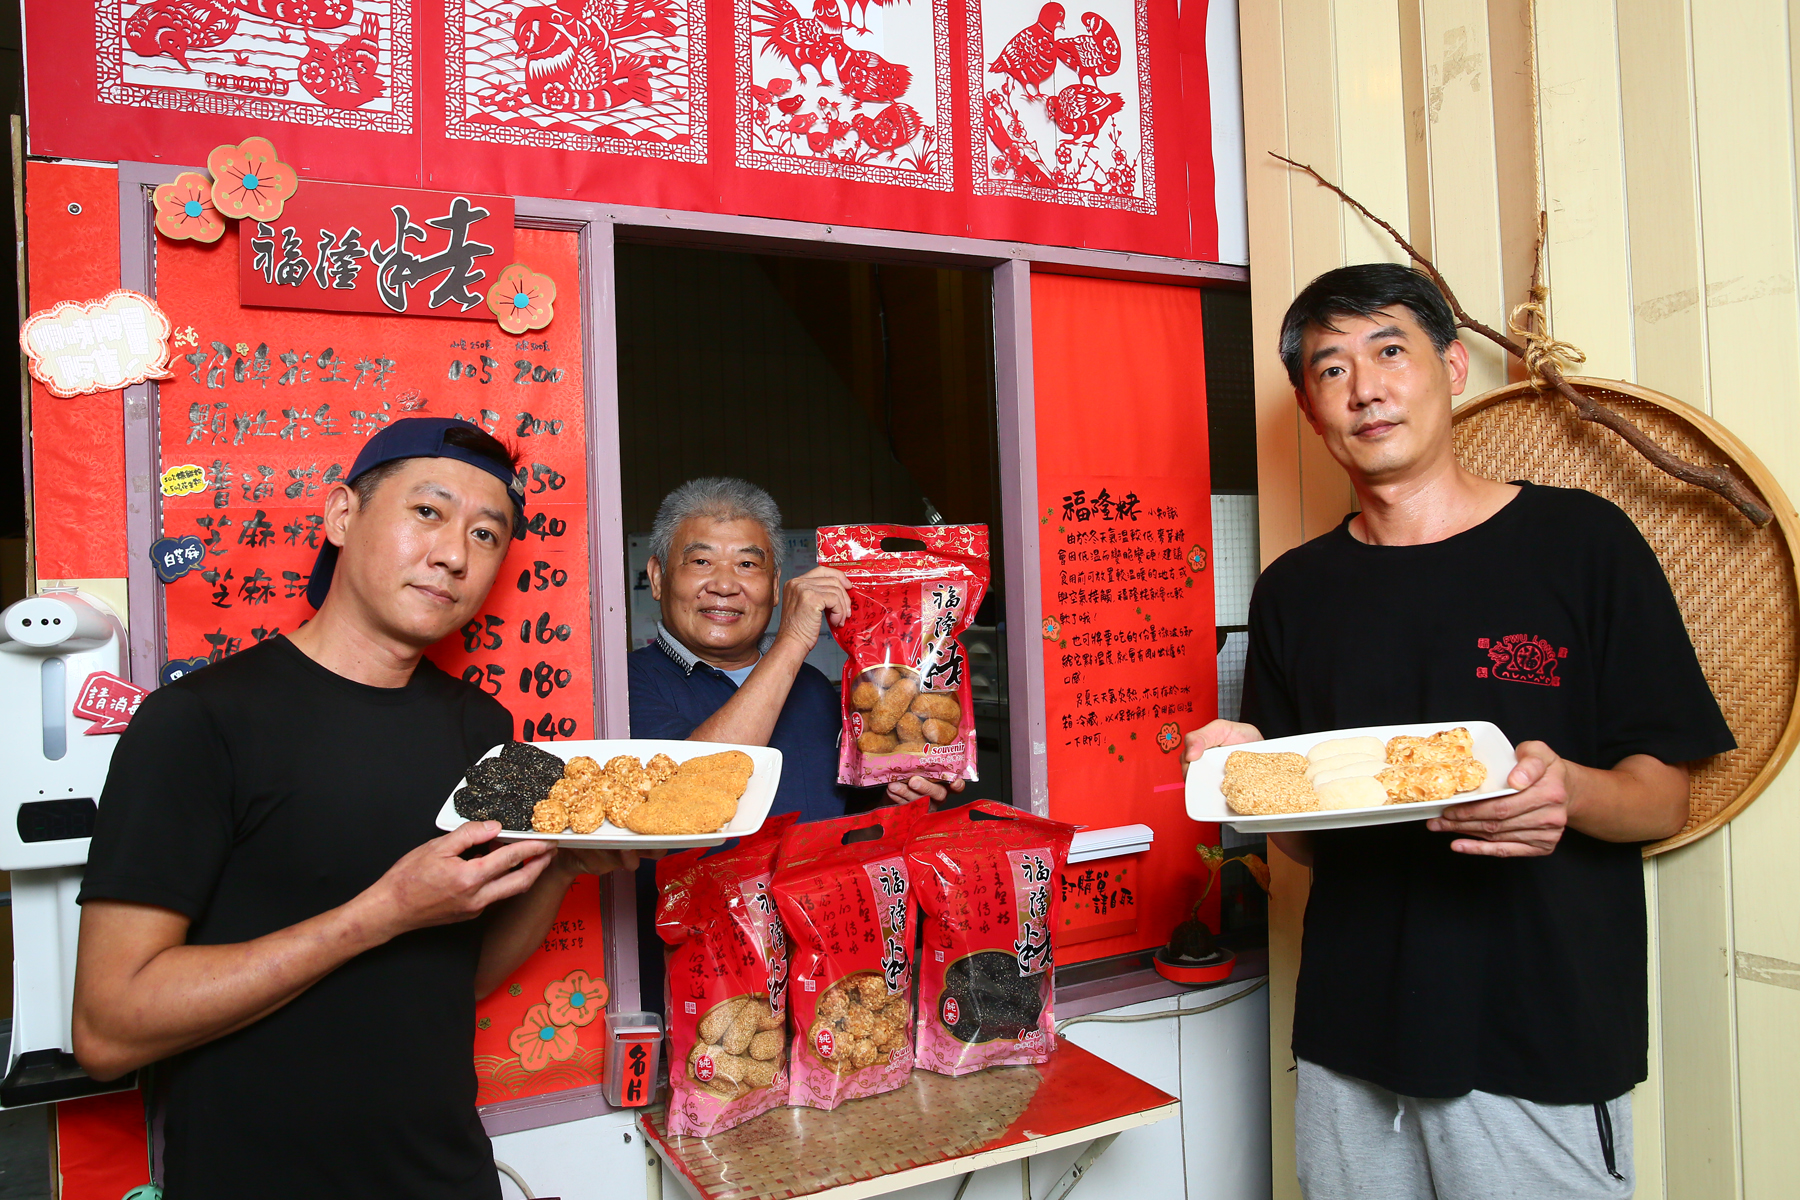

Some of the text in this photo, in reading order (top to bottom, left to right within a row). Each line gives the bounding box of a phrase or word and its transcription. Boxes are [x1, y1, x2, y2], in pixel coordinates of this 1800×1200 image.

[448, 355, 499, 384] 105
[514, 359, 565, 385] 200
[515, 412, 565, 438] 200
[519, 463, 566, 495] 150
[515, 512, 567, 542] 140
[1148, 506, 1179, 520] 小知識
[164, 544, 200, 568] 白芝麻
[517, 561, 568, 593] 150
[461, 614, 505, 653] 85
[520, 611, 572, 644] 160
[1503, 633, 1528, 645] FWU
[519, 661, 572, 699] 180
[523, 713, 577, 742] 140
[931, 742, 966, 755] souvenir
[819, 1033, 832, 1054] 純素
[627, 1043, 647, 1102] 名片
[698, 1058, 712, 1078] 純素
